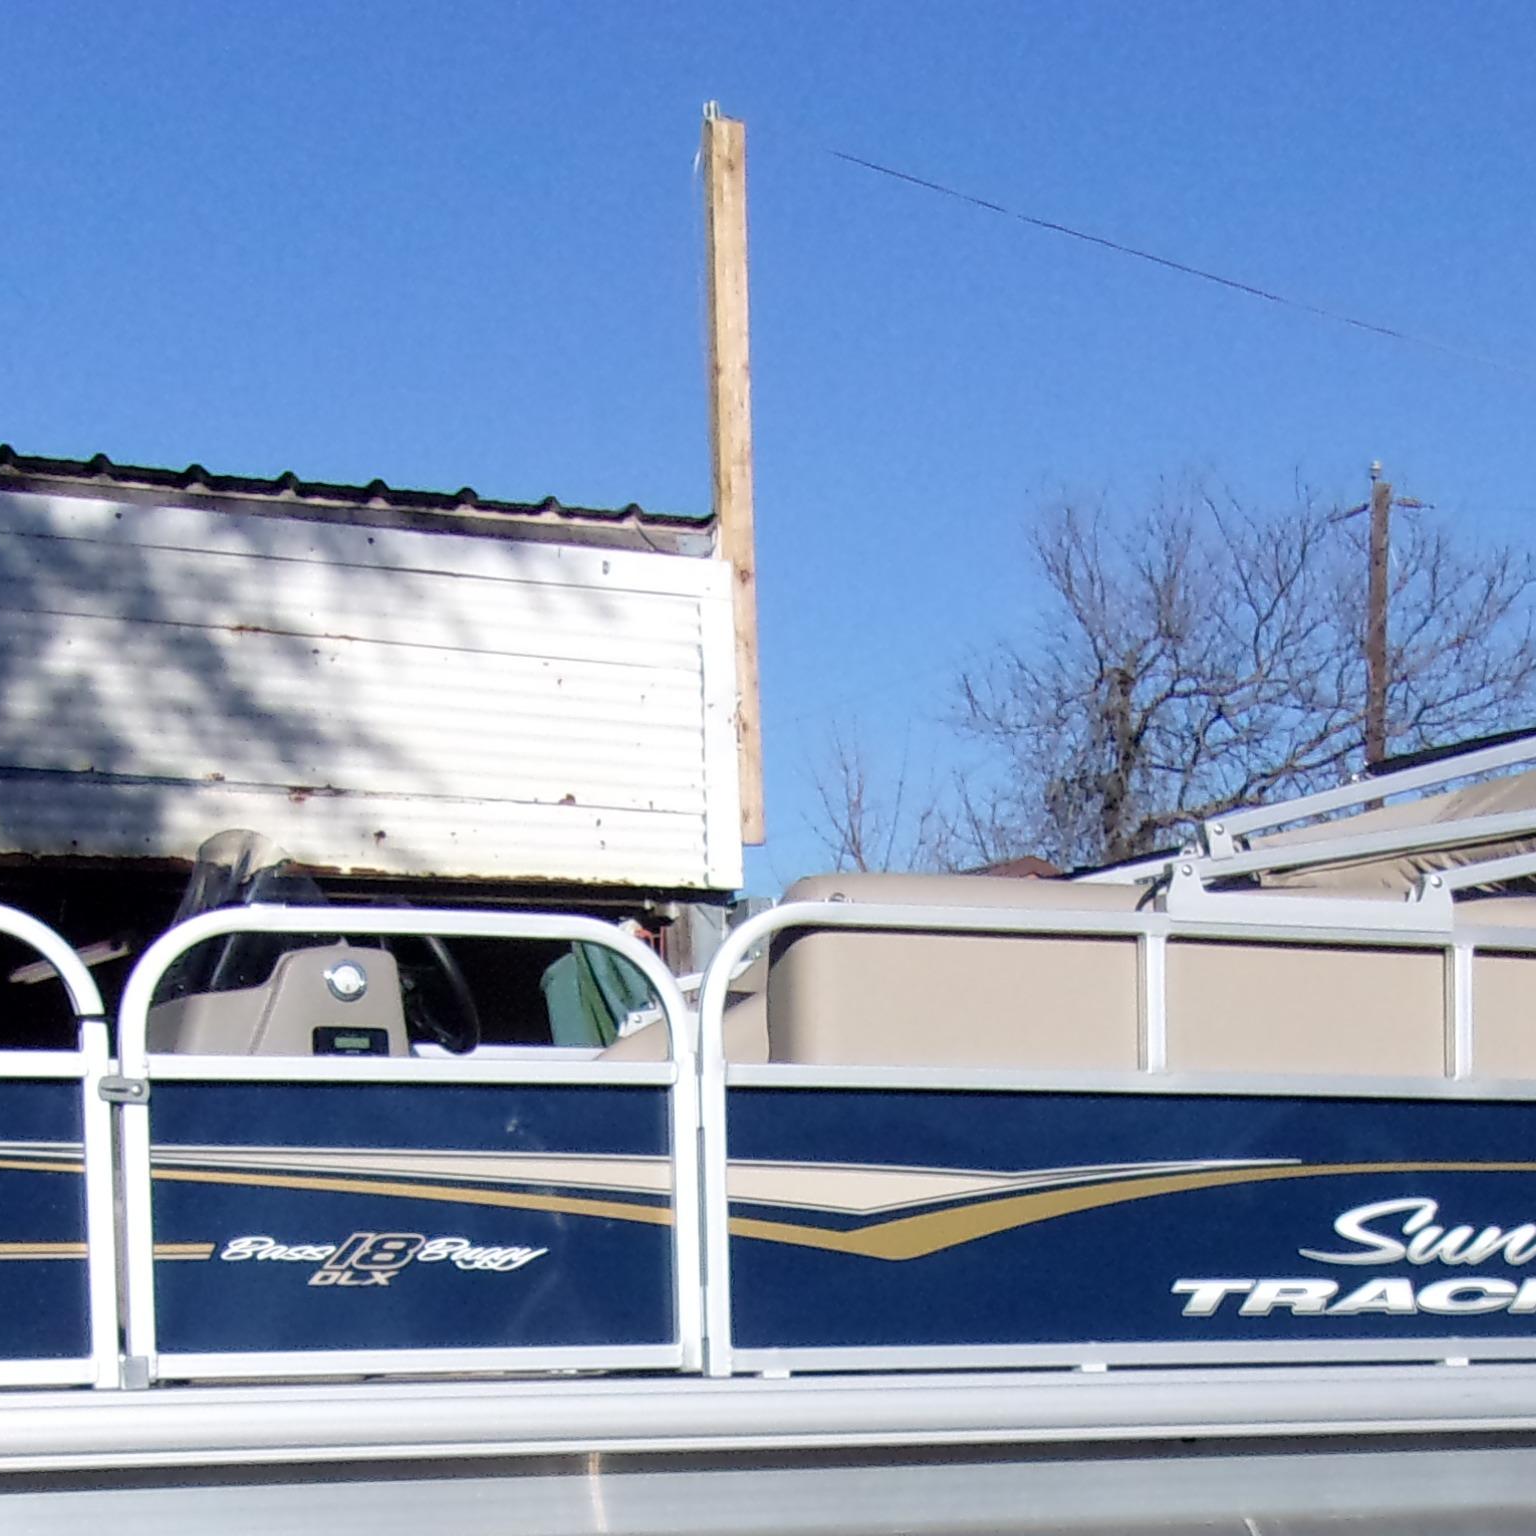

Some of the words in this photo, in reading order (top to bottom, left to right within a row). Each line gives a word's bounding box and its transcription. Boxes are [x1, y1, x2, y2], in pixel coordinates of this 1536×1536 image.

[220, 1235, 337, 1261] Bass
[323, 1232, 427, 1271] 18
[416, 1236, 549, 1272] Buggy
[307, 1270, 400, 1287] DLX
